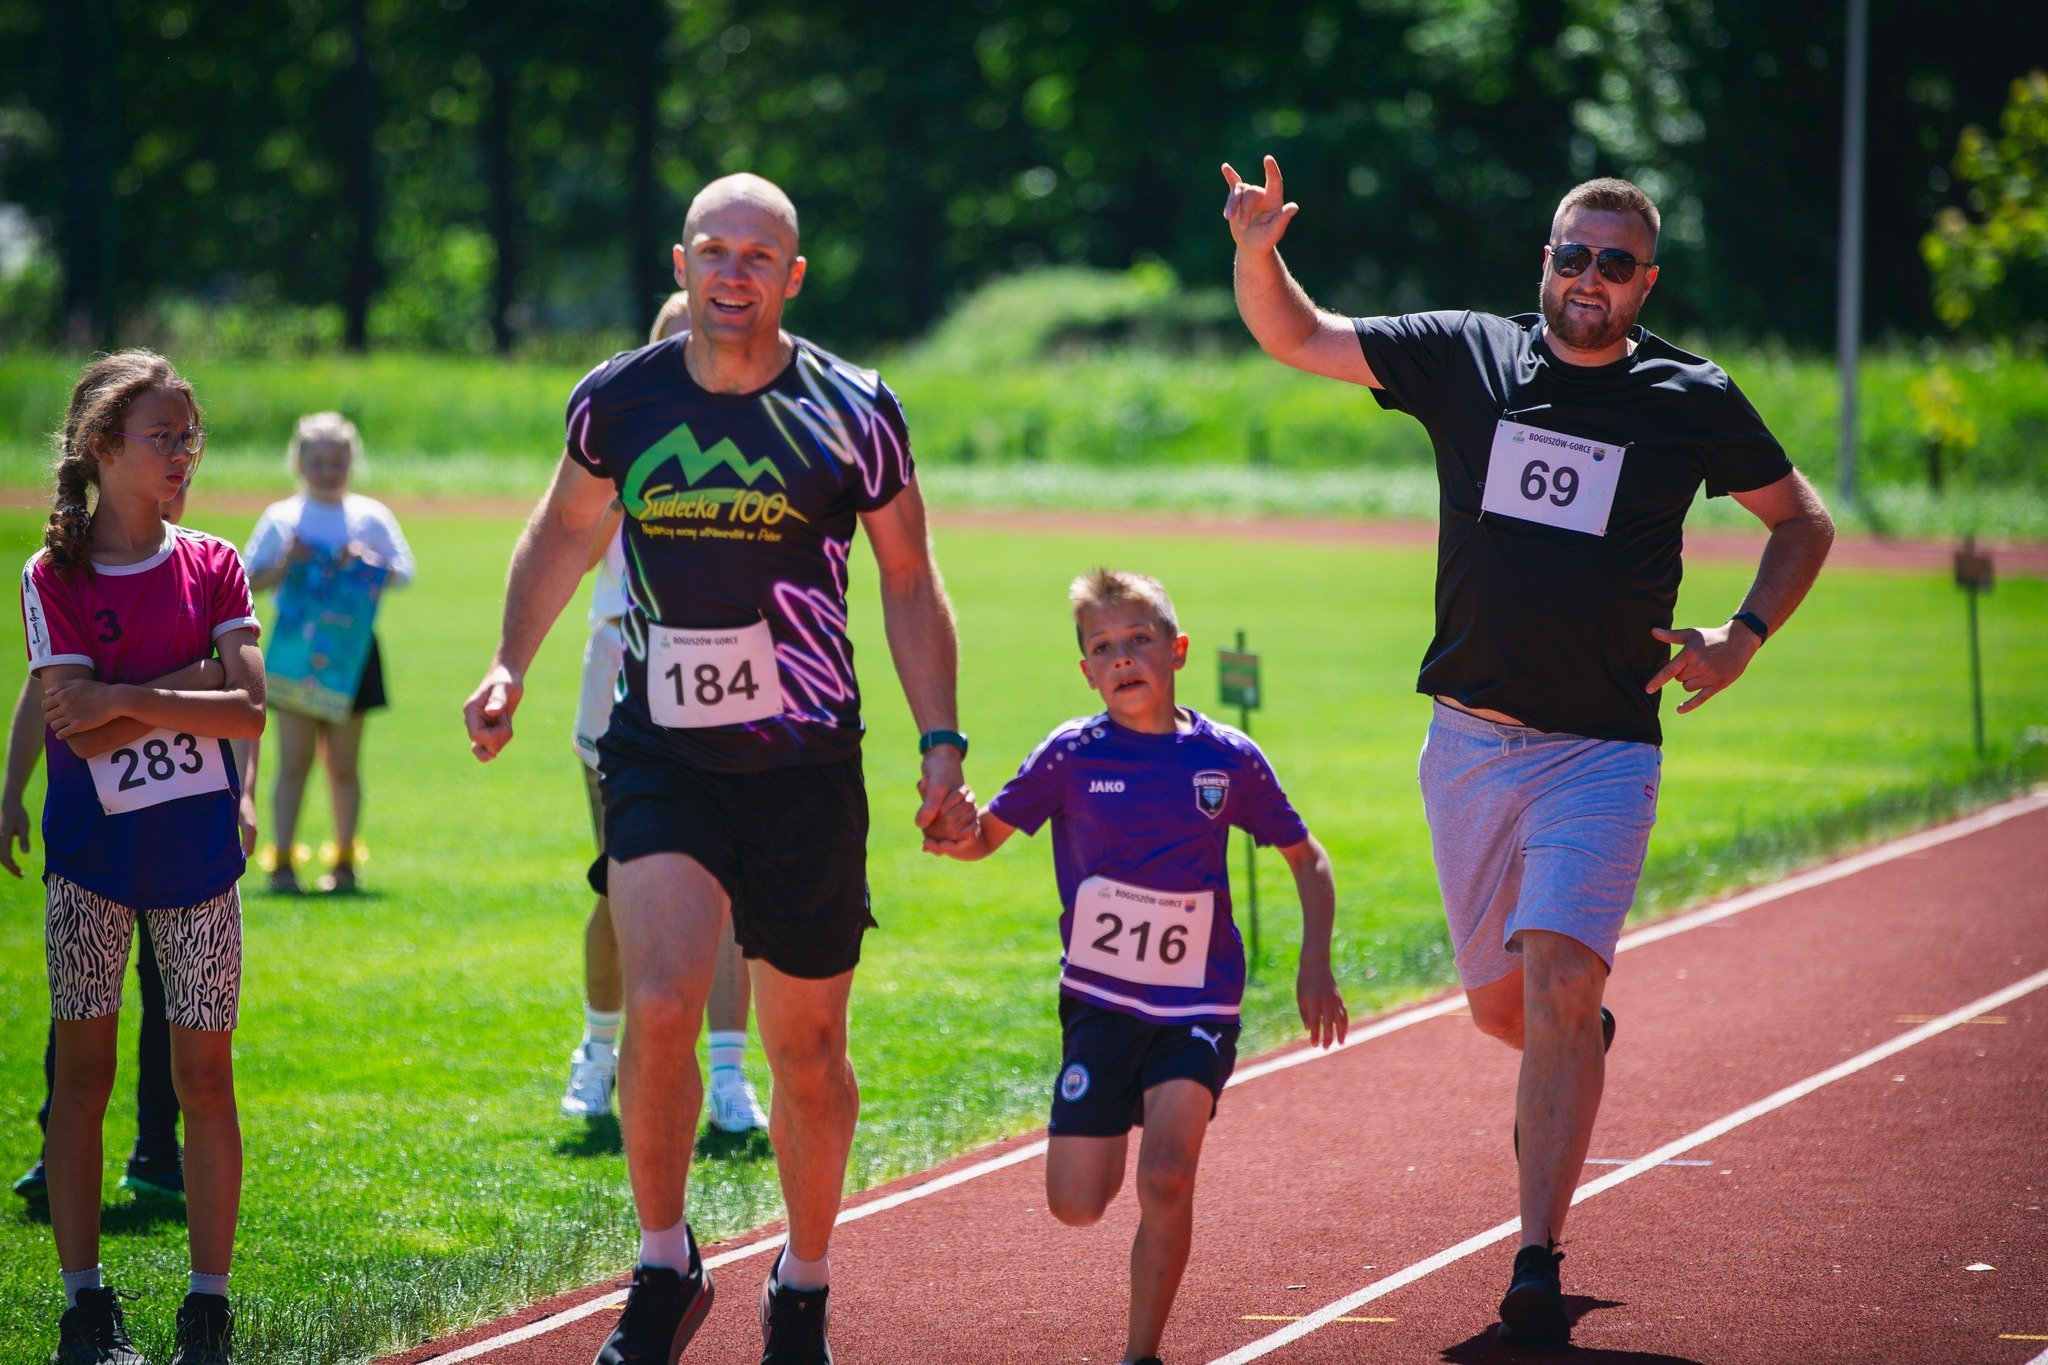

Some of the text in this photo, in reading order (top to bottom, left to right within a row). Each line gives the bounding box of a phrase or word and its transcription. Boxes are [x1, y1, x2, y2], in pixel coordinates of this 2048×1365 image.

[1528, 432, 1592, 454] BOGUSZÓW-GORCE
[1520, 459, 1580, 507] 69
[638, 483, 789, 525] Sudecka 100
[94, 609, 122, 644] 3
[672, 636, 739, 646] BOGUSZÓW-GORCE
[664, 659, 759, 707] 184
[110, 732, 204, 792] 283
[1088, 779, 1126, 793] JAKO
[1193, 777, 1230, 788] DIAMENT
[1090, 912, 1189, 966] 216
